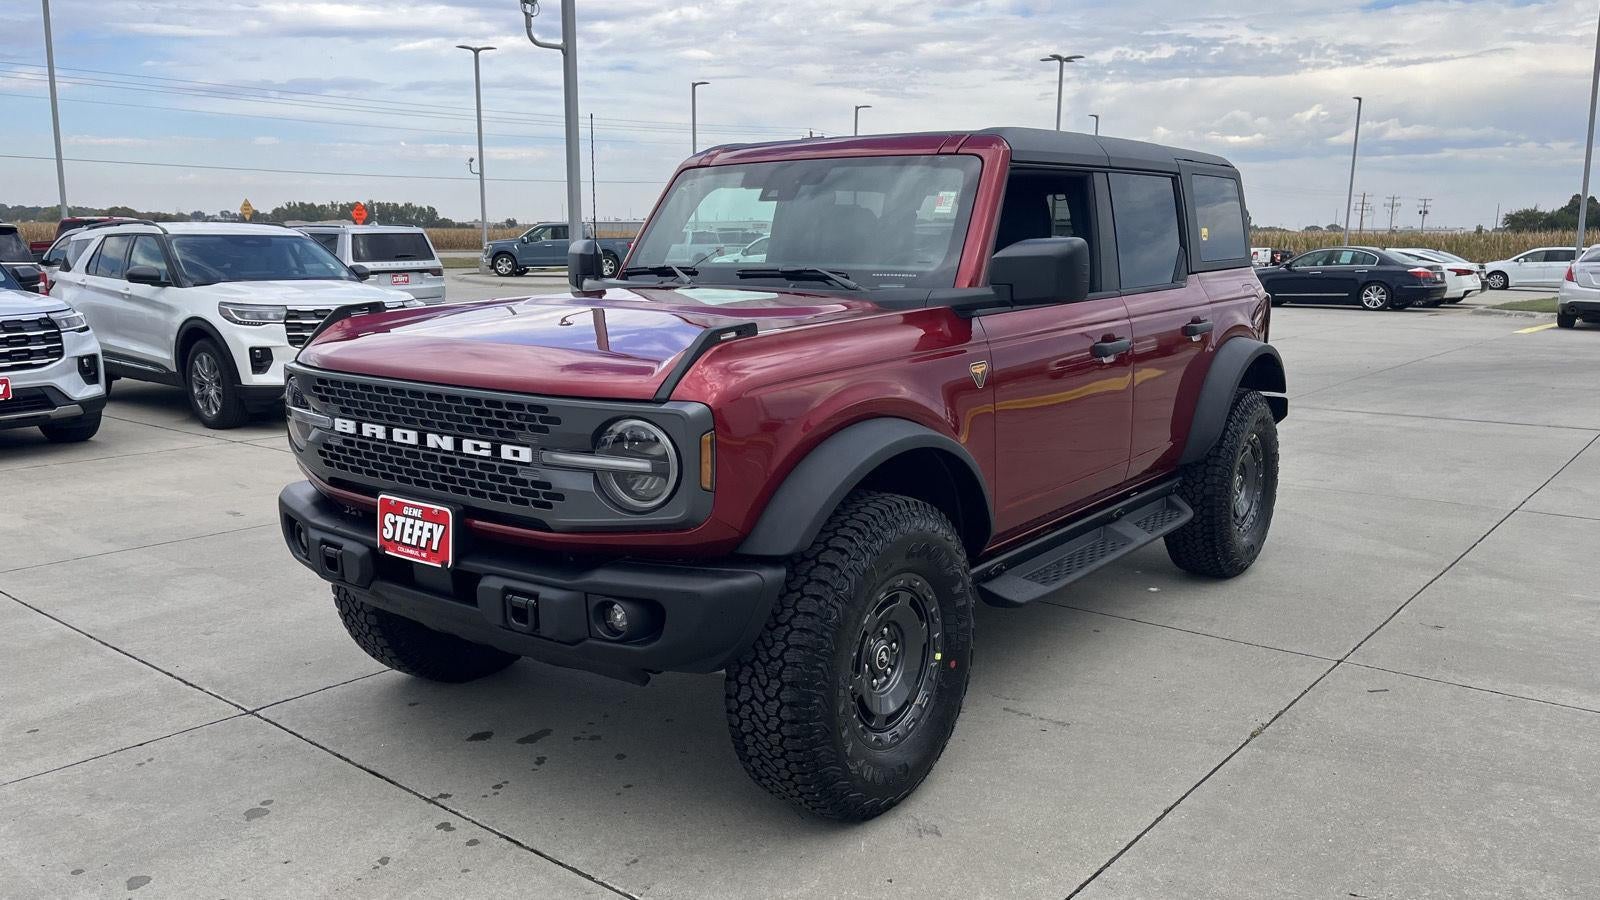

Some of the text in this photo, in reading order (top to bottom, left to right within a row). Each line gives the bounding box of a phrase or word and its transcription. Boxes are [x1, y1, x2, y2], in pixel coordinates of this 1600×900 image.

[334, 418, 531, 462] BRONCO
[403, 506, 423, 518] GENE
[383, 513, 445, 551] STEFFY
